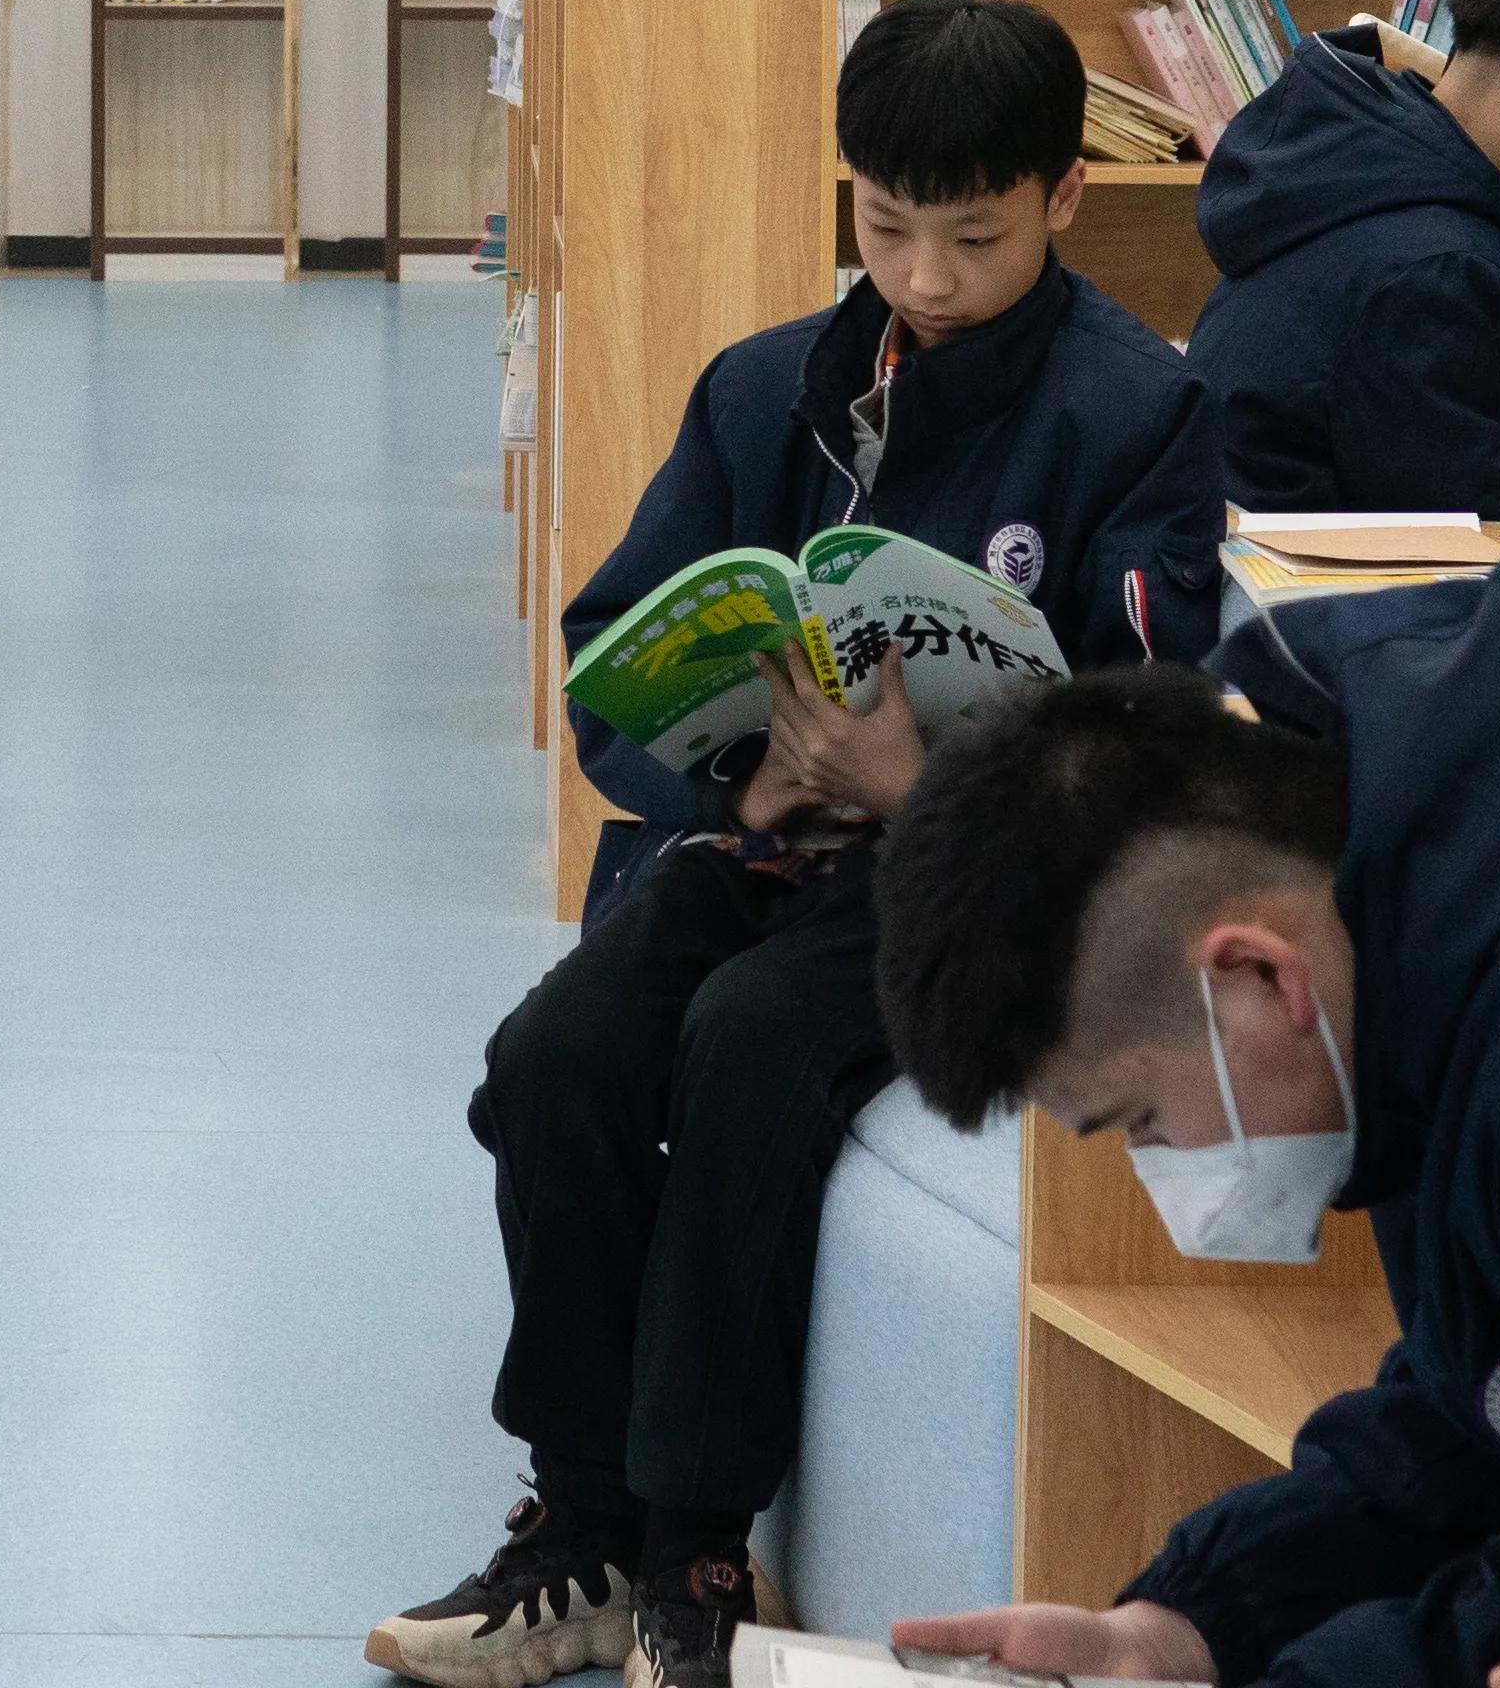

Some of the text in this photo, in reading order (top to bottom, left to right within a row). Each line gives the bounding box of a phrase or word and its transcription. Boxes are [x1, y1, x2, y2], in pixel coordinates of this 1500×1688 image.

[827, 602, 865, 635] 中考
[880, 594, 970, 620] 名校模考
